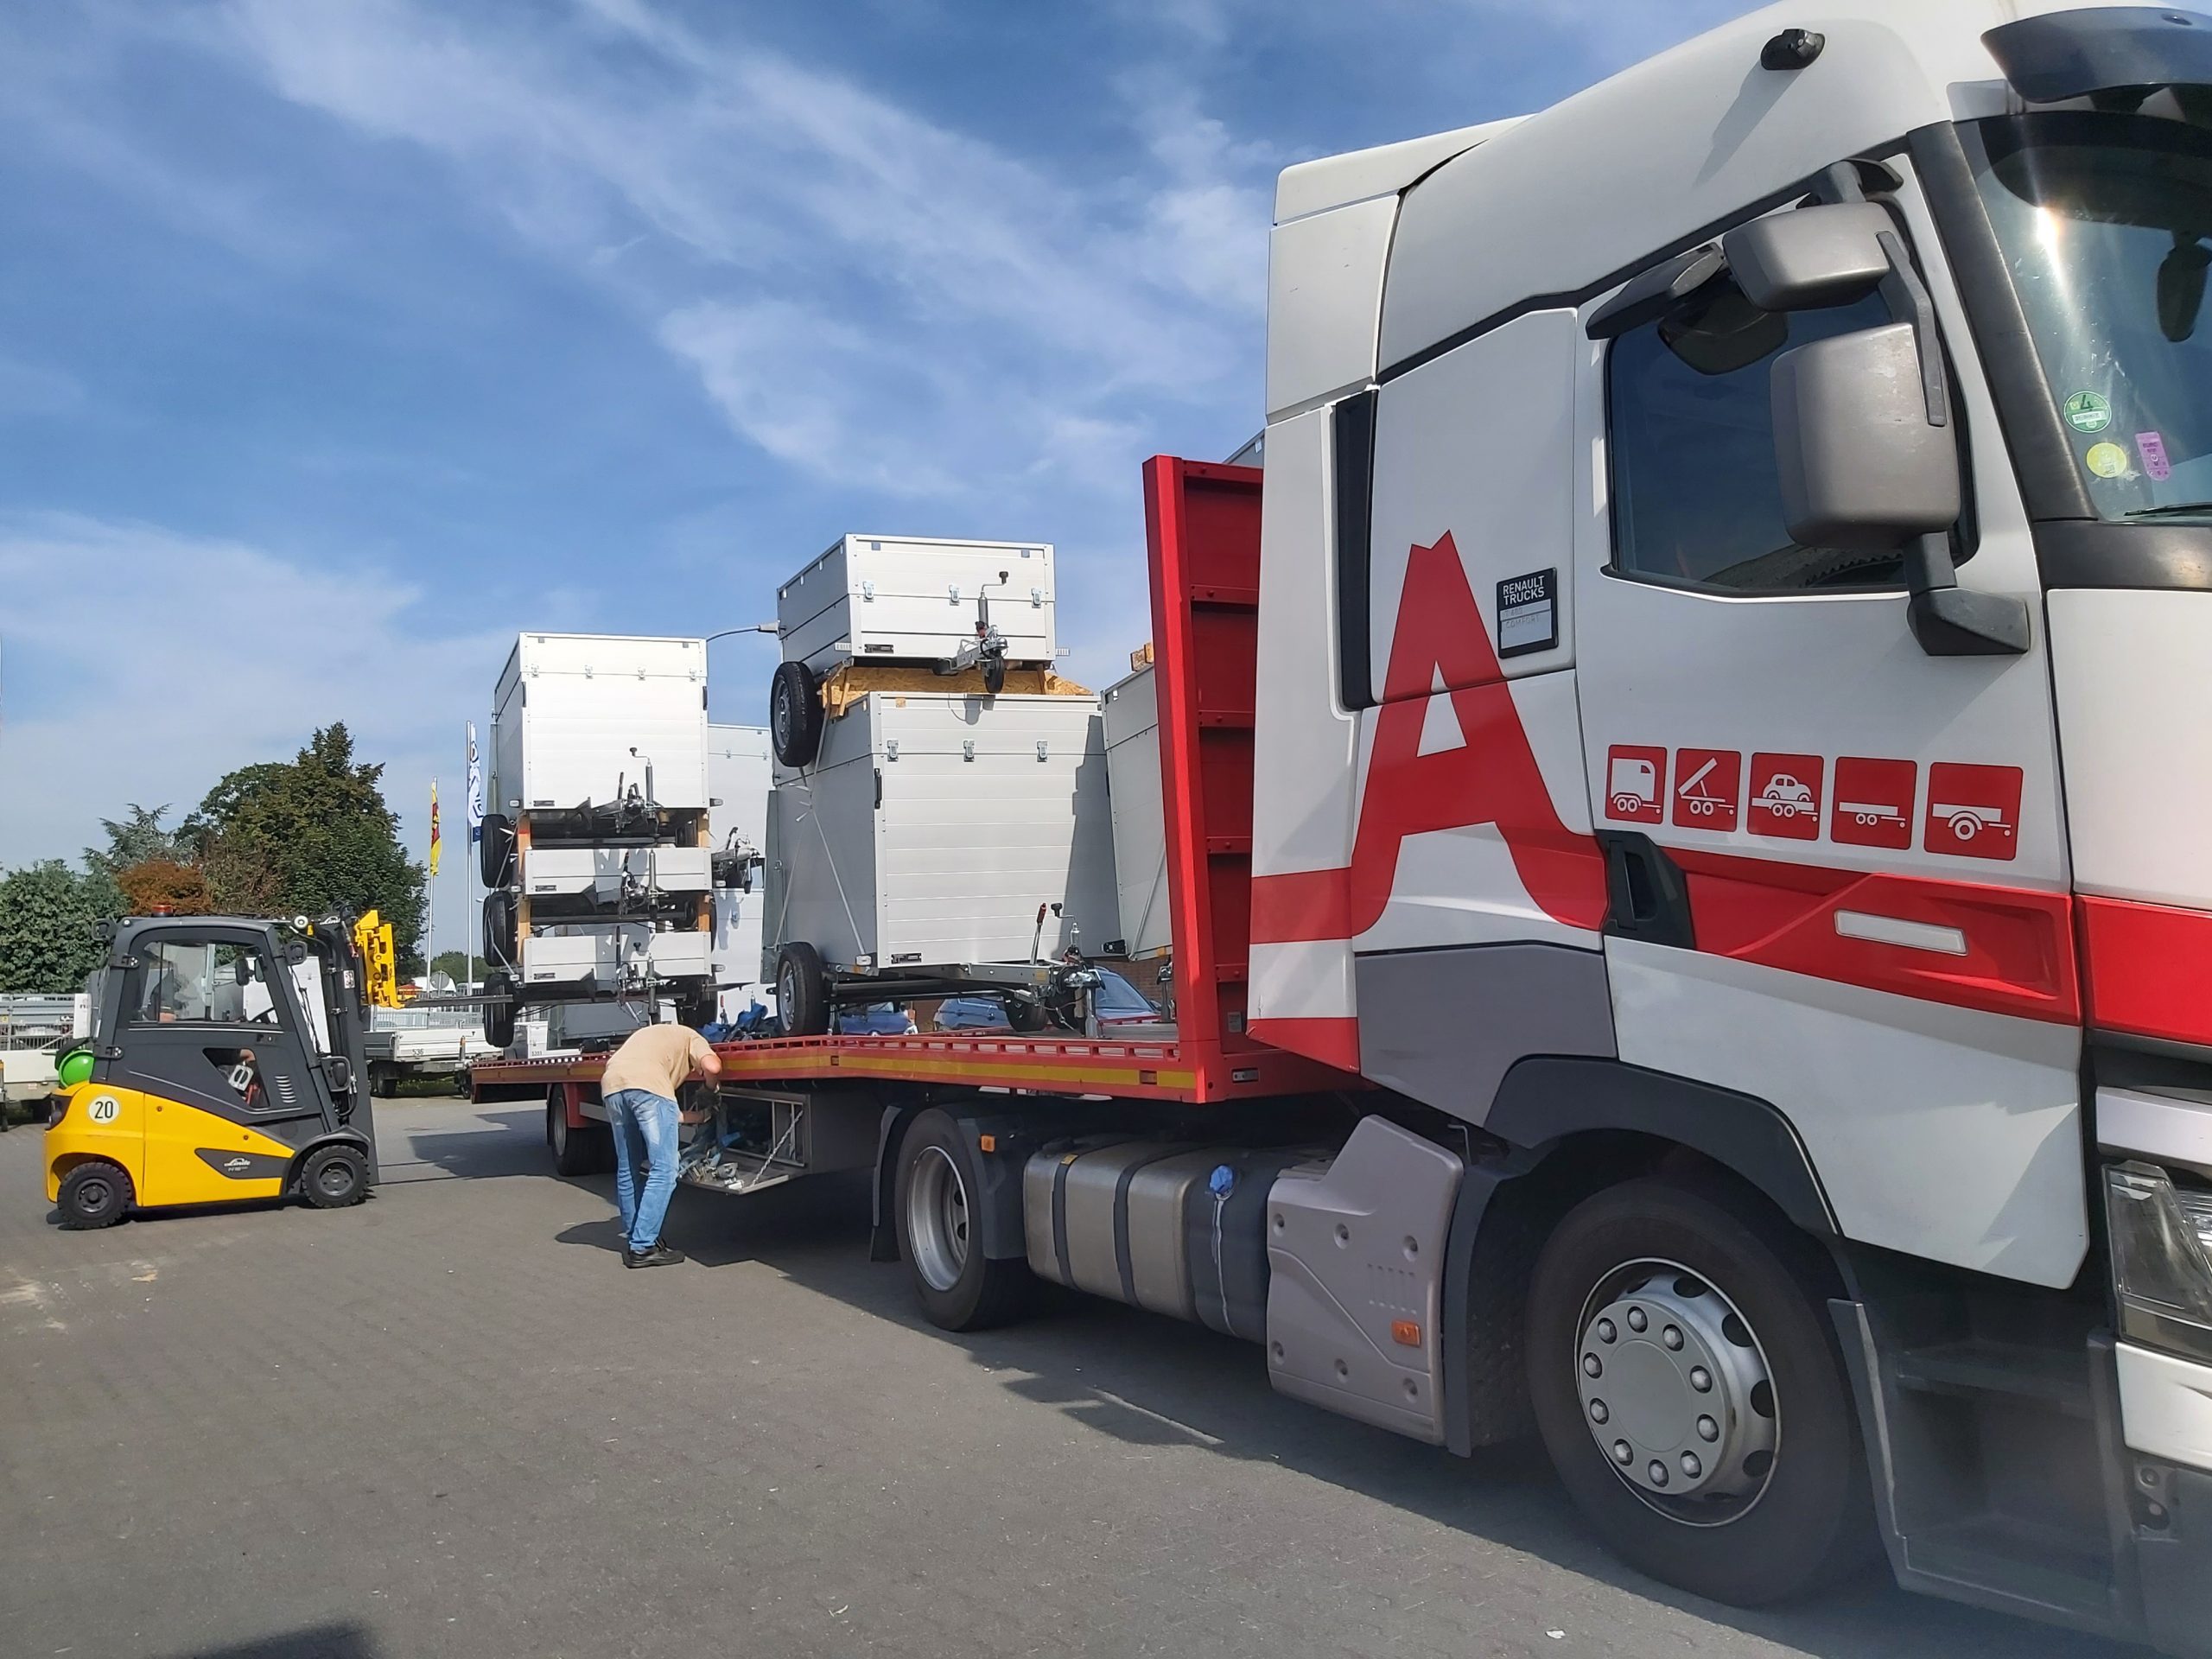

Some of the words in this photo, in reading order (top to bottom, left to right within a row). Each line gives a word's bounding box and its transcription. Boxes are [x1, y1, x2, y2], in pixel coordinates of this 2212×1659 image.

[2080, 394, 2094, 411] 4
[1503, 575, 1545, 595] RENAULT
[1503, 586, 1545, 606] TRUCKS
[1505, 614, 1540, 629] COMFORT
[319, 916, 341, 925] Lind
[94, 1101, 113, 1119] 20
